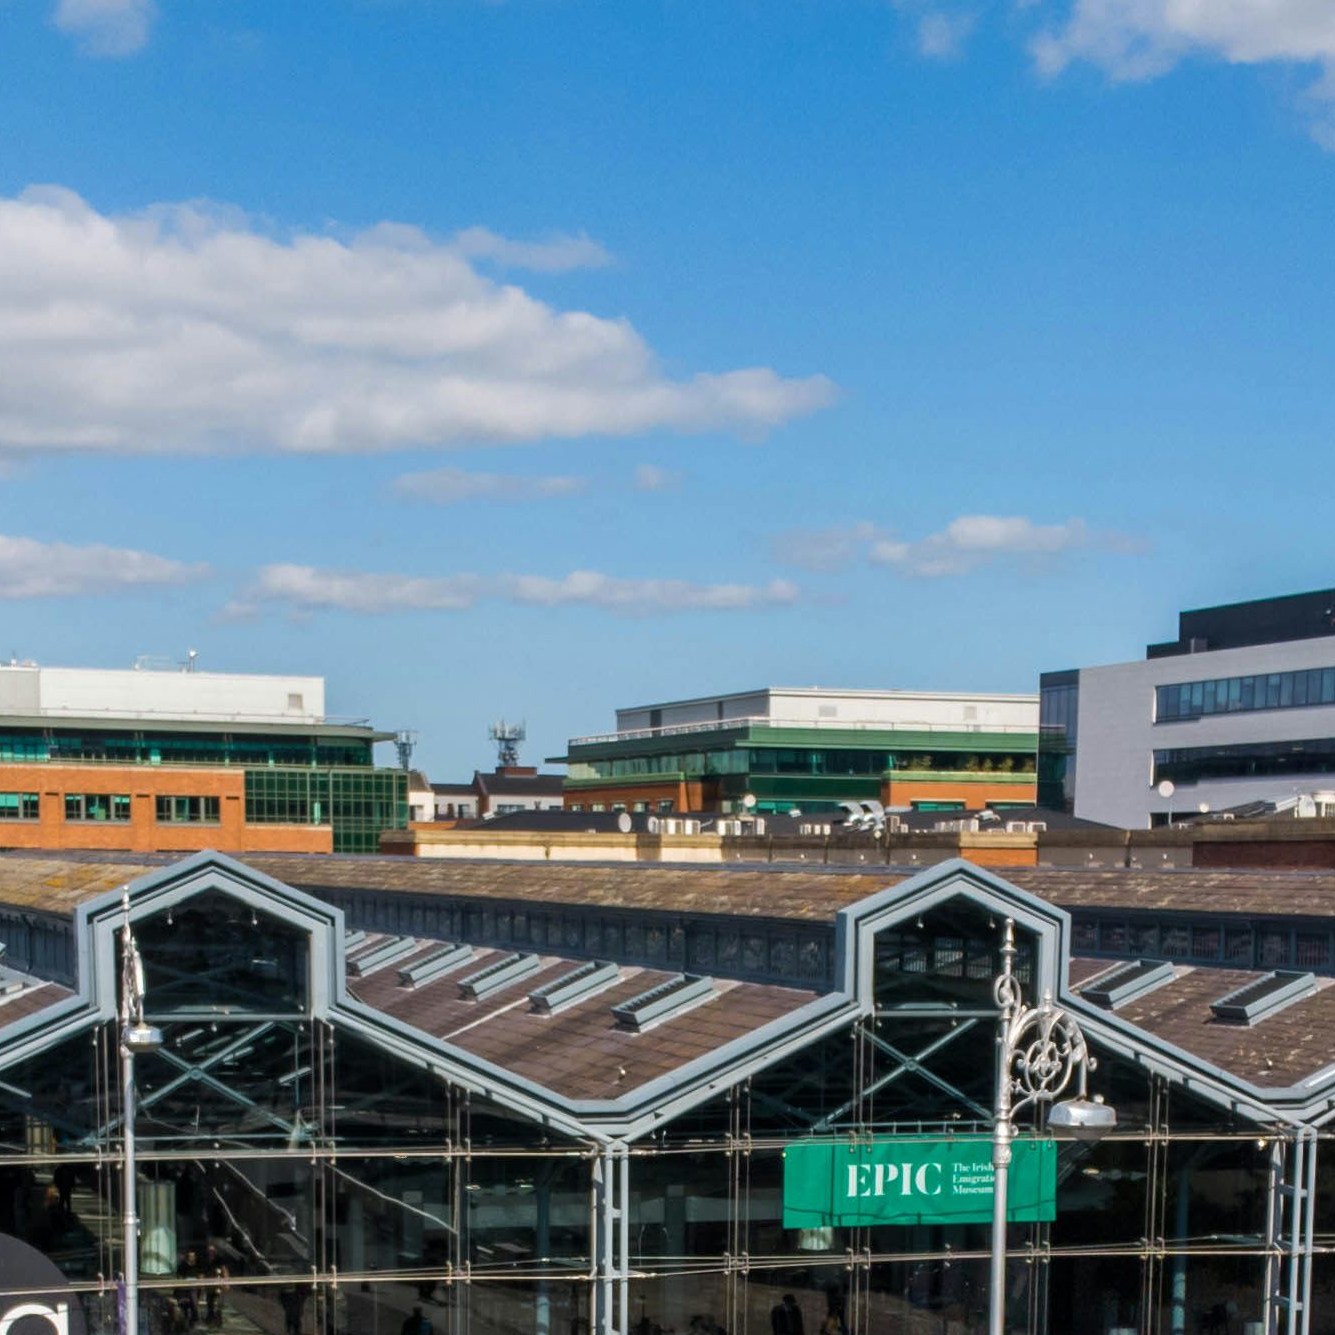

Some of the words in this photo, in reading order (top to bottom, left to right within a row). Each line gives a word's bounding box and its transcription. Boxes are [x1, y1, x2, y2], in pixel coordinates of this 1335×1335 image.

[952, 1163, 970, 1172] The
[846, 1162, 942, 1198] EPIC
[952, 1185, 994, 1195] Museum
